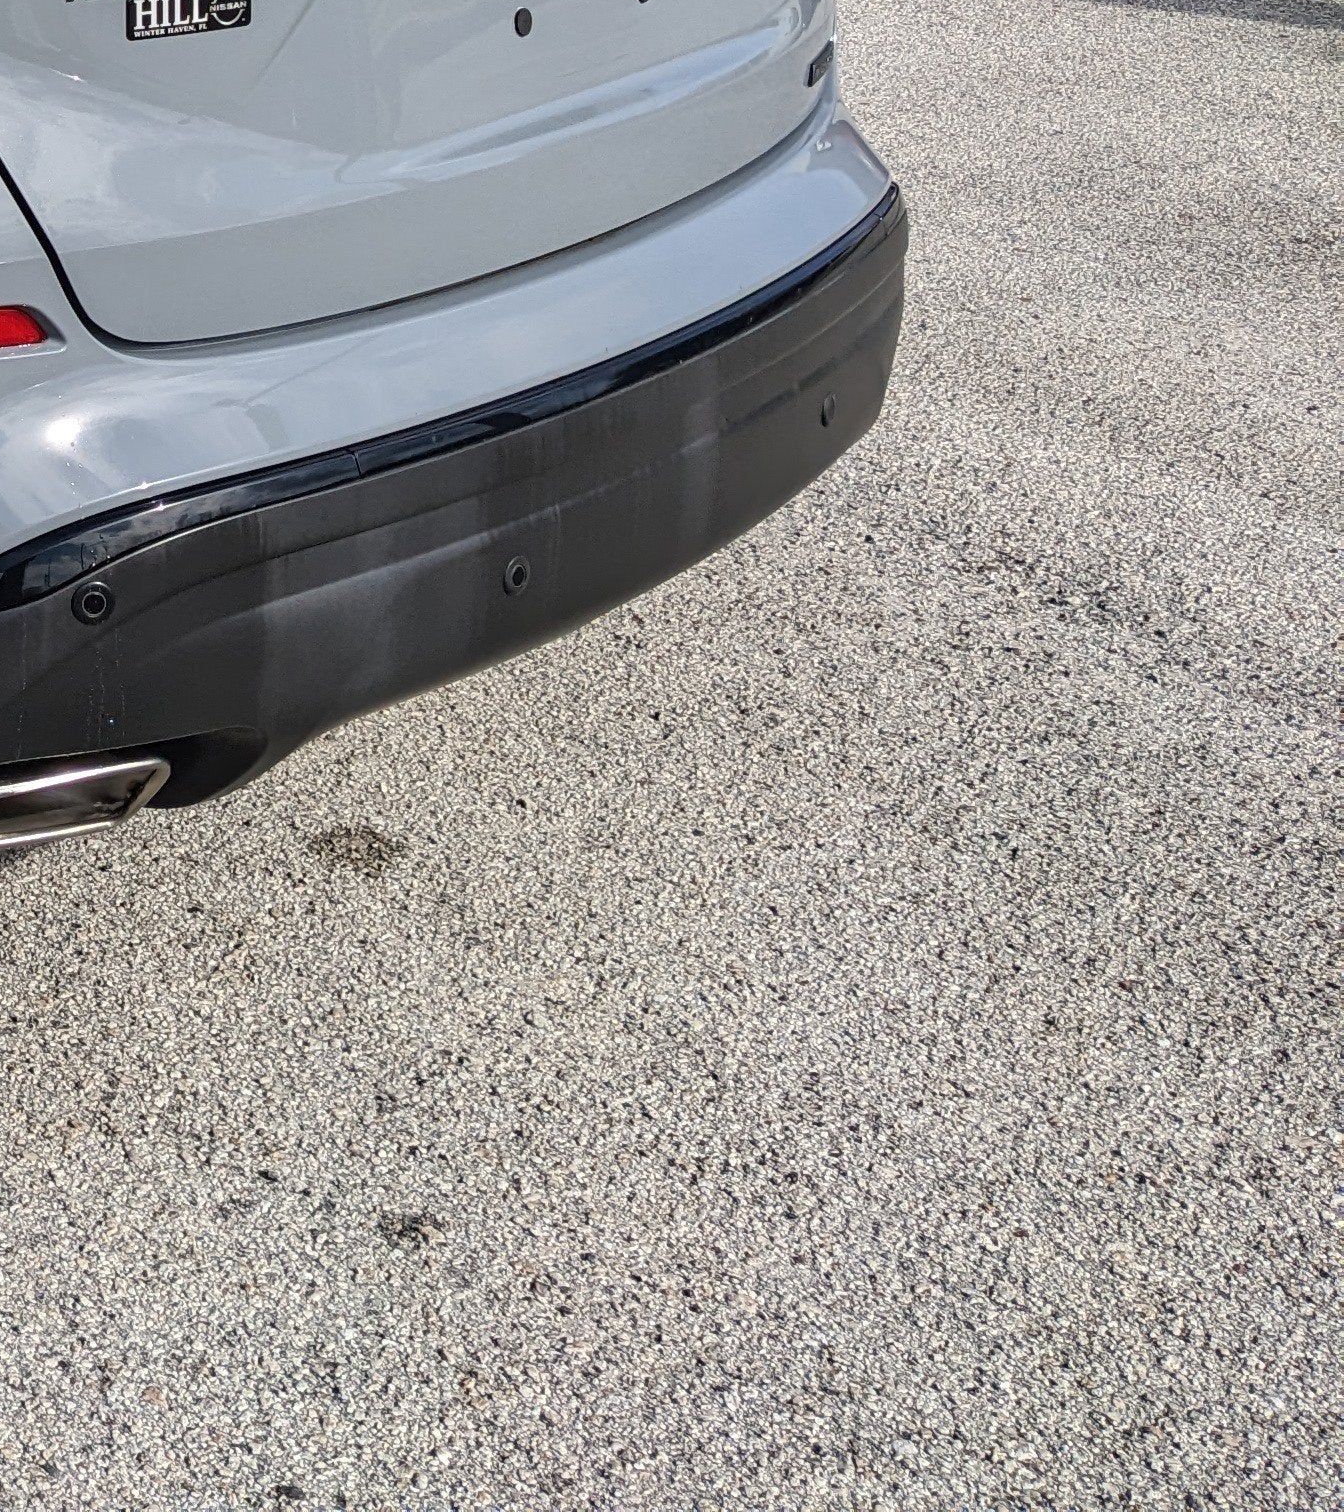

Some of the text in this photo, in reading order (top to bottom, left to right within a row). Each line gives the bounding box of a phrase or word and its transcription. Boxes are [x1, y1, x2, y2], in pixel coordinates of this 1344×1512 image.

[209, 0, 247, 12] NISSAN
[133, 28, 165, 38] WINTER
[198, 23, 208, 31] FL
